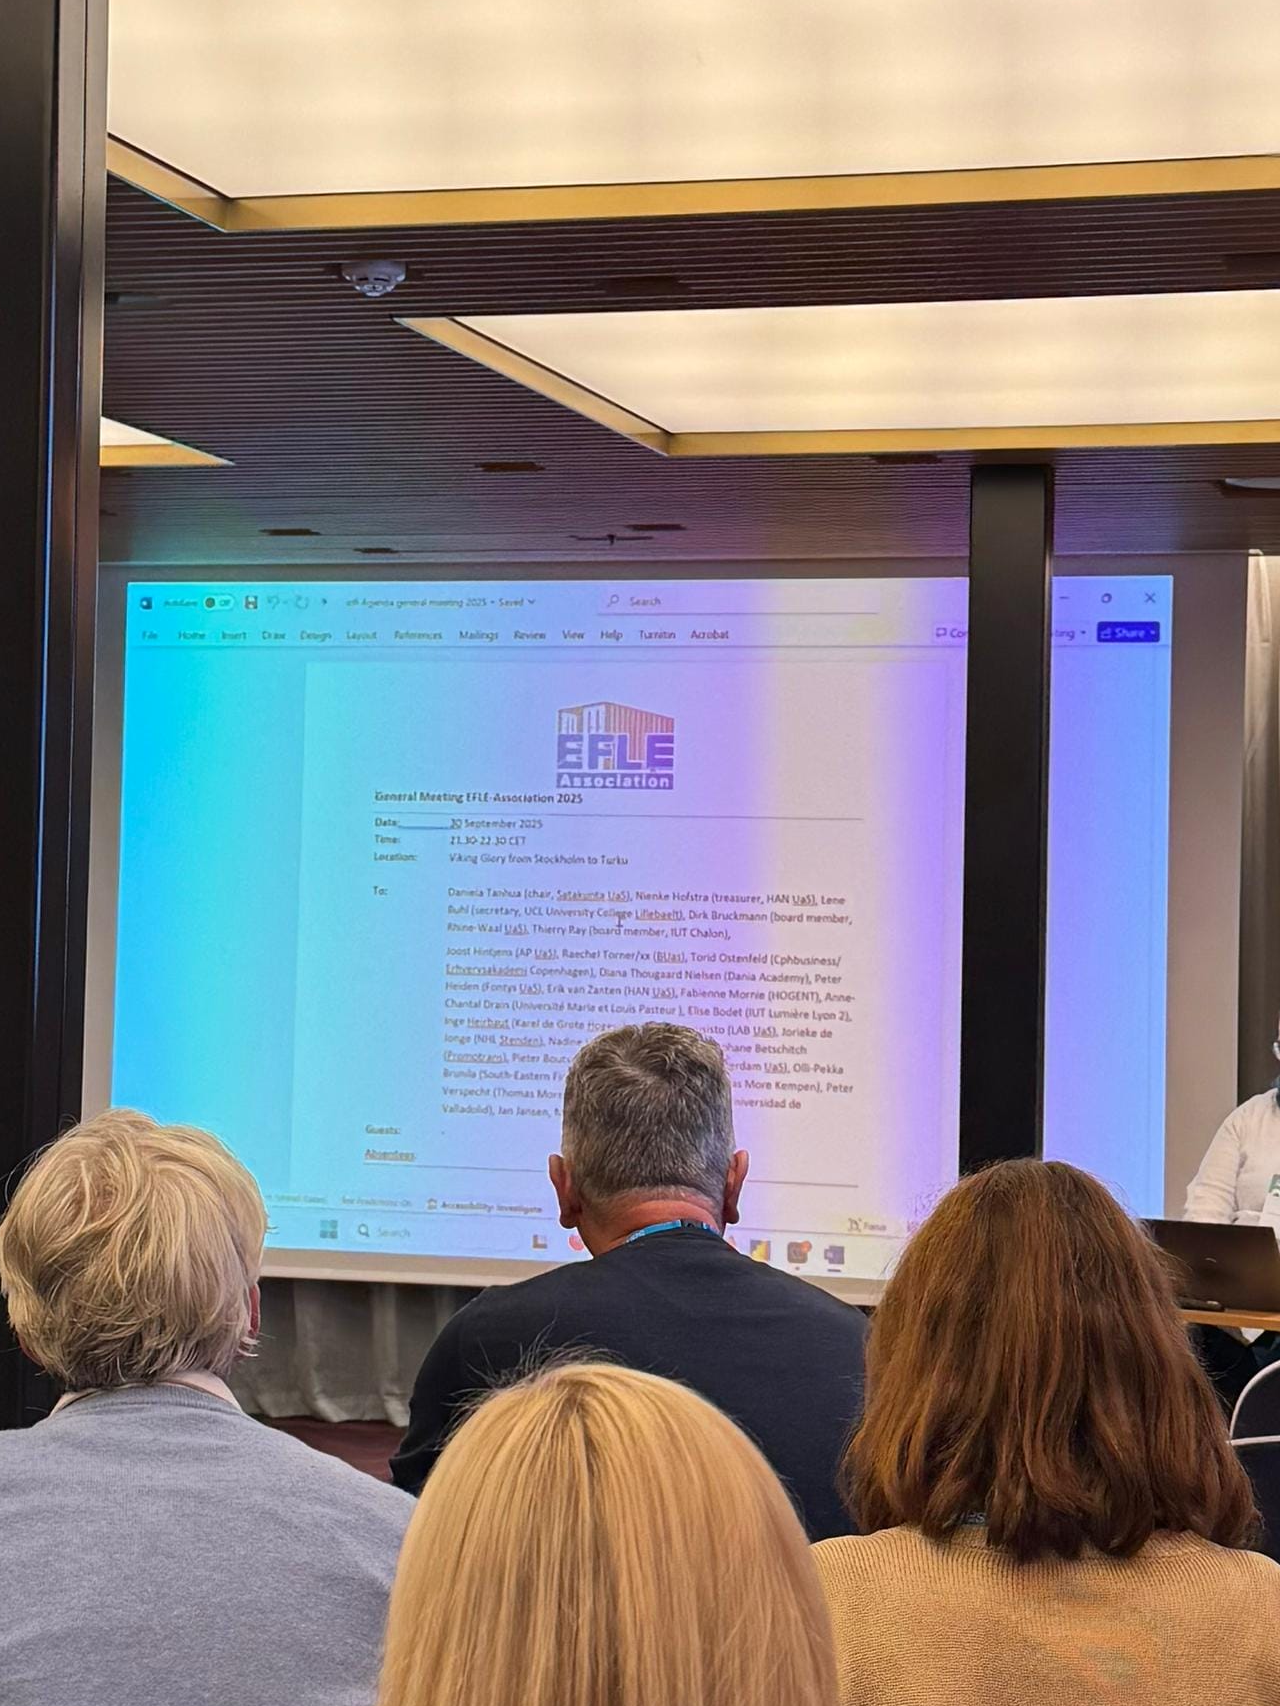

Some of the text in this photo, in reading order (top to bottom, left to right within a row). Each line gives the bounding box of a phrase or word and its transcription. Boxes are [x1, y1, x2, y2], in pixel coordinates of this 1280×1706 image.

[396, 597, 428, 609] general
[429, 597, 464, 609] meeting
[465, 597, 487, 607] 2025
[498, 597, 524, 607] Saved
[629, 596, 661, 607] Search
[178, 630, 206, 641] Home
[221, 630, 247, 641] Insert
[261, 630, 287, 641] Draw
[300, 630, 332, 643] Design
[346, 630, 377, 643] Layout
[393, 630, 443, 641] References
[459, 629, 499, 643] Mailings
[513, 629, 547, 641] Review
[561, 629, 585, 640] View
[600, 629, 623, 642] Help
[690, 629, 729, 640] Acrobat
[1052, 628, 1075, 641] ting
[1114, 627, 1146, 639] Share
[557, 733, 675, 771] EFLE
[559, 773, 670, 789] Association
[374, 791, 583, 805] General Meeting EFLE-Association 2025
[374, 818, 401, 829] Date:
[464, 818, 517, 831] September
[519, 819, 543, 829] 2025
[374, 835, 401, 845] Time:
[373, 852, 629, 866] Location: Viking Glory from Stockholm to Turku
[524, 888, 554, 901] (chair,
[635, 891, 670, 902] Nienke
[671, 891, 709, 903] Hofstra
[711, 892, 764, 905] (treasurer,
[766, 894, 790, 905] HAN
[791, 895, 818, 907] UaS),
[821, 895, 846, 906] Lene
[471, 906, 853, 926] (secretary, UCL University College Dirk Bruckmann (board member,
[532, 924, 567, 936] Thierry
[588, 925, 622, 938] (board
[623, 928, 669, 940] member,
[670, 927, 688, 939] IUT
[690, 928, 731, 941] Chalon),
[446, 946, 471, 957] Joost
[515, 947, 533, 960] (AP
[561, 948, 601, 960] Raechel
[719, 953, 768, 965] Ostenfeld
[770, 954, 842, 969] (Cphbusiness/
[529, 965, 596, 979] Copenhagen),
[599, 967, 628, 978] Diana
[630, 969, 683, 982] Thougaard
[684, 970, 721, 981] Nielsen
[723, 971, 756, 983] (Dania
[758, 972, 812, 985] Academy),
[814, 974, 842, 984] Peter
[445, 981, 480, 992] Heiden
[546, 983, 565, 994] Erik
[567, 985, 586, 994] van
[587, 985, 621, 996] Zanten
[623, 985, 651, 998] (HAN
[652, 987, 678, 999] UaS),
[680, 988, 727, 999] Fabienne
[768, 990, 822, 1003] (HOGENT),
[824, 992, 856, 1003] Anne-
[444, 999, 853, 1023] Chantal Drain (Université Marie et Louis Pasteur Elise Bodet (IUT Lumière Lyon 2),
[511, 1018, 540, 1031] (Karel
[542, 1019, 555, 1029] de
[556, 1020, 585, 1030] Grote
[727, 1026, 833, 1039] (LAB UaS), Jorieke de
[473, 1034, 497, 1046] (NHL
[548, 1037, 582, 1047] Nadine
[722, 1043, 752, 1055] phane
[511, 1053, 540, 1064] Pieter
[727, 1061, 762, 1072] erdam
[764, 1063, 790, 1075] UaS),
[479, 1069, 551, 1081] (South-Eastern
[493, 1087, 535, 1099] (Thomas
[744, 1080, 772, 1090] More
[774, 1081, 823, 1094] Kempen),
[825, 1083, 854, 1094] Peter
[734, 1098, 802, 1110] niversidad de
[498, 1106, 514, 1116] Jan
[516, 1107, 552, 1118] Jansen,
[497, 1204, 543, 1215] Investigate
[378, 1228, 411, 1239] Search
